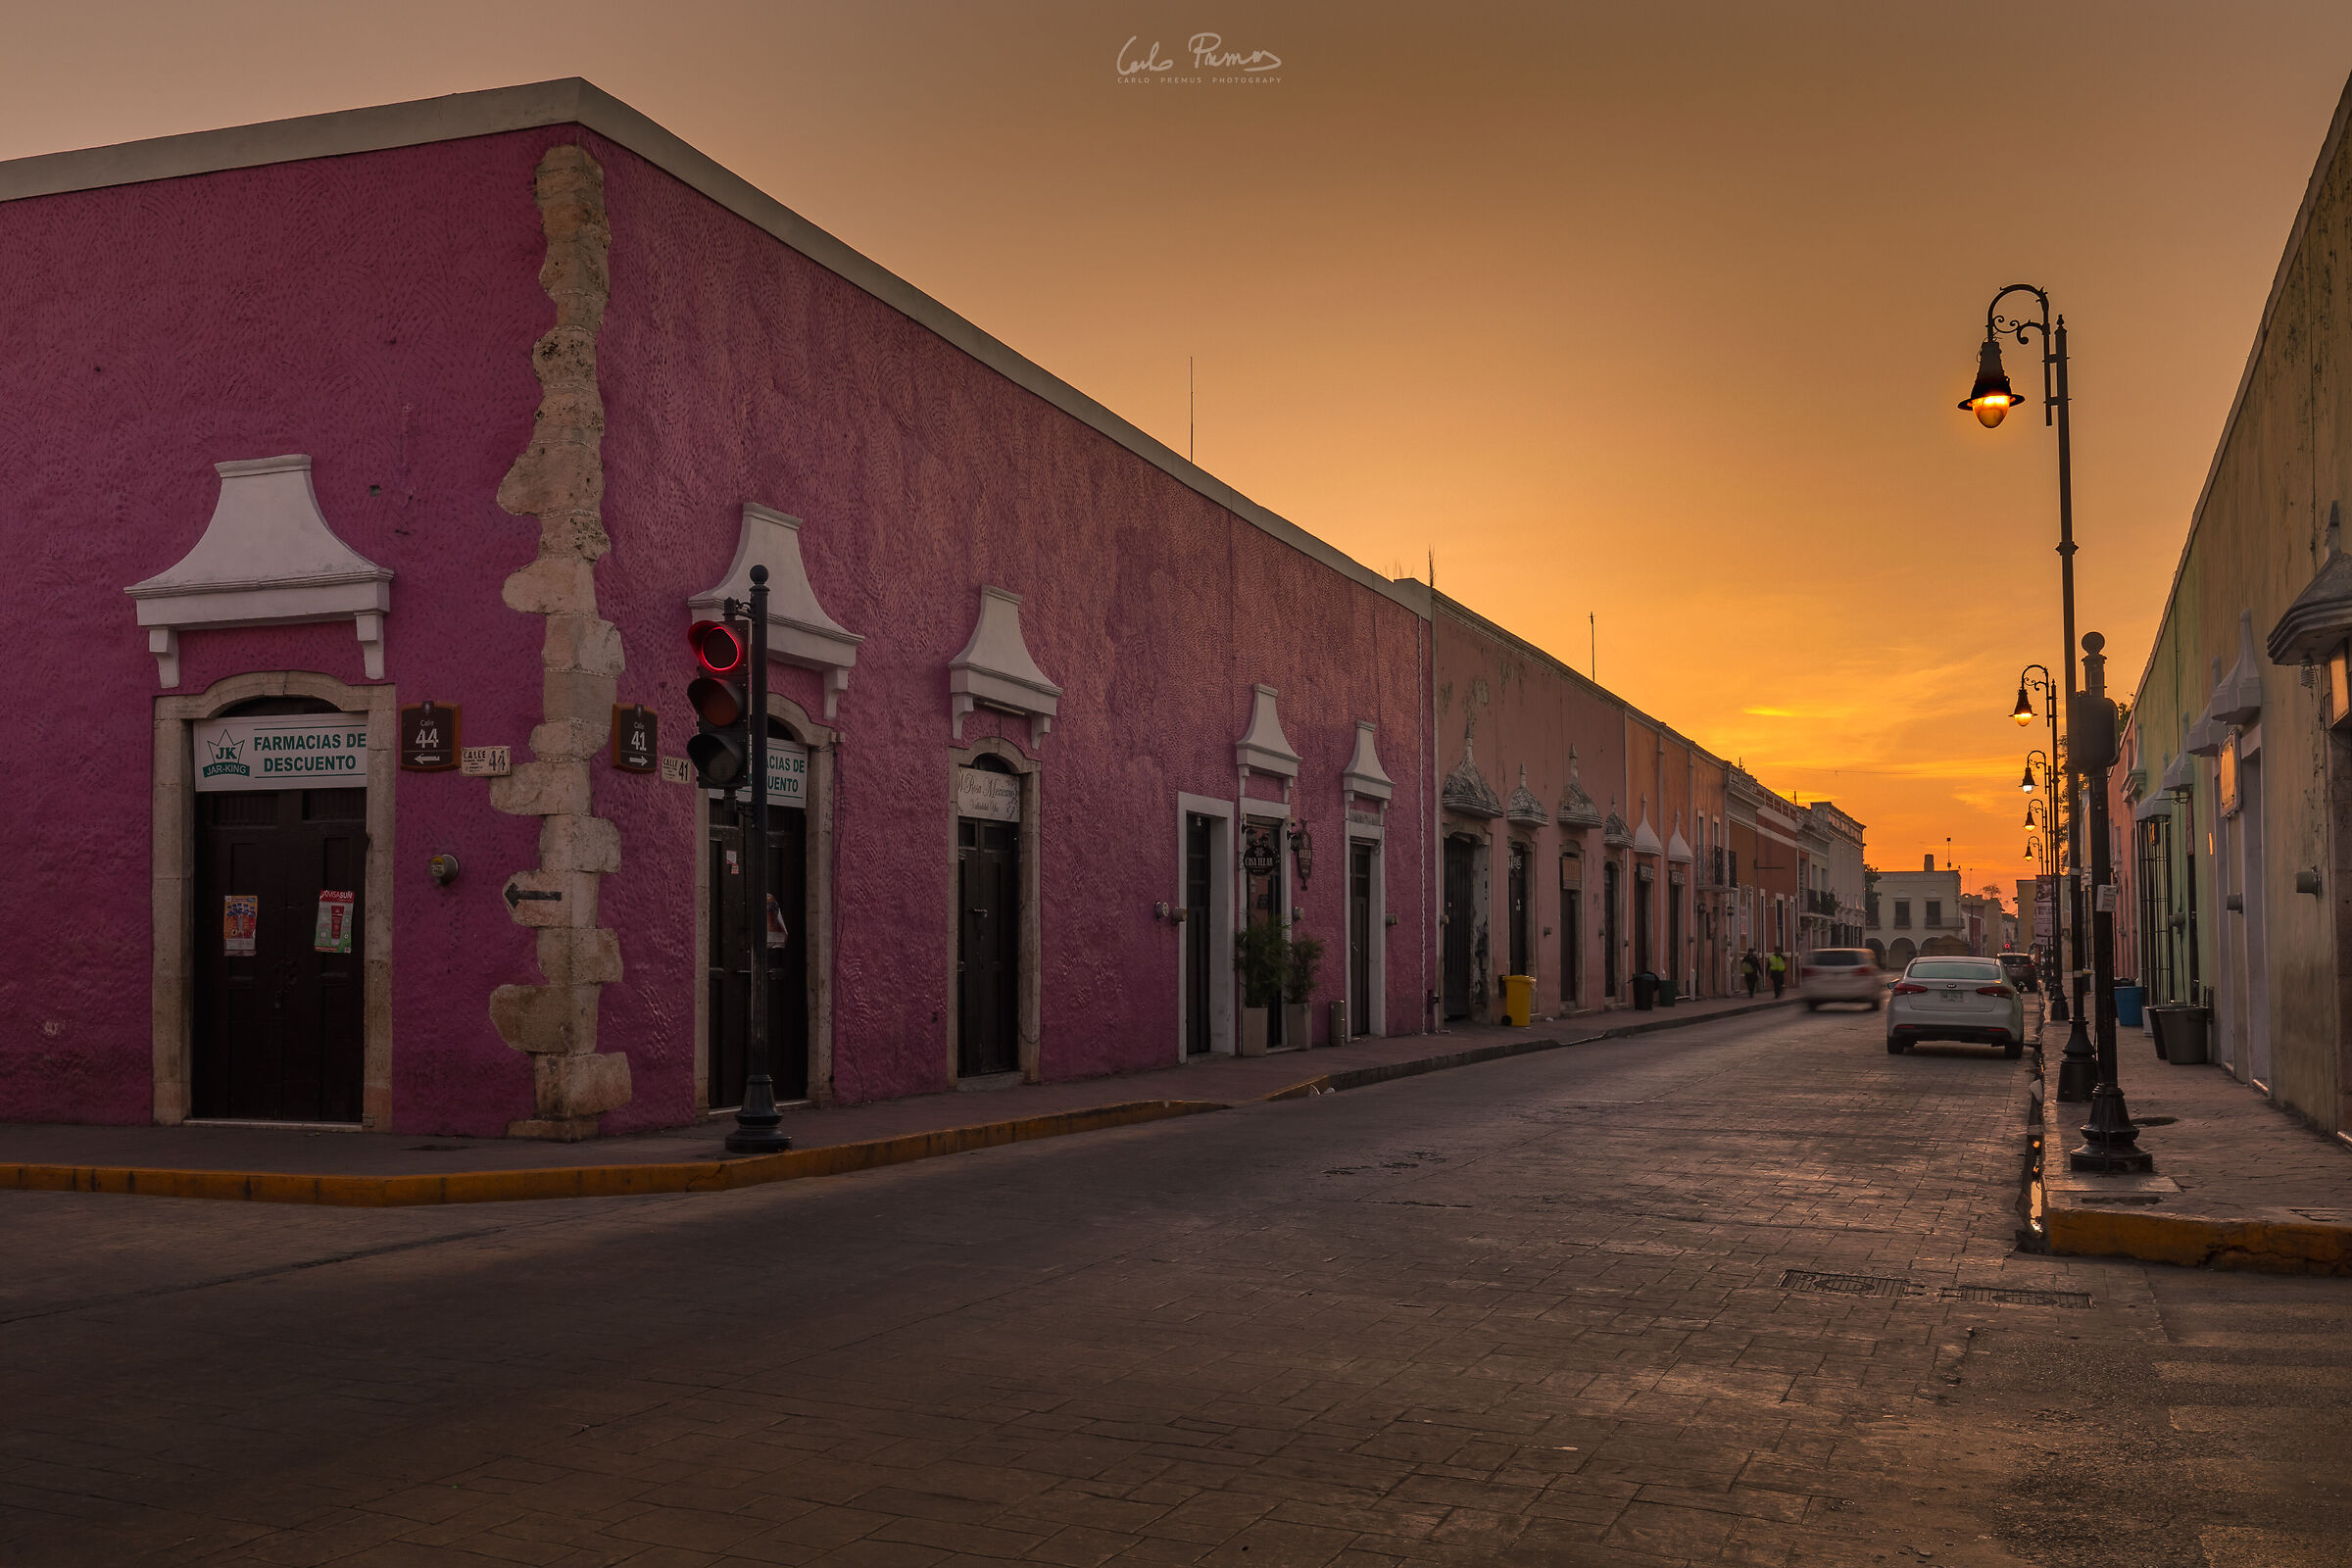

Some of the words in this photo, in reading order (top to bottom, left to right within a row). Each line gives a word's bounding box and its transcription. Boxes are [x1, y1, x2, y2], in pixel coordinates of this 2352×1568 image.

[254, 733, 341, 752] FARMACIAS
[346, 732, 367, 749] DE
[415, 727, 440, 749] 44
[630, 730, 647, 752] 41
[216, 747, 237, 760] JK
[264, 755, 357, 772] DESCUENTO
[463, 750, 486, 760] CALLE
[488, 750, 506, 771] 44
[205, 764, 247, 776] JAR-KING
[662, 758, 678, 767] CALLE
[678, 760, 689, 782] 41
[793, 760, 805, 773] DE
